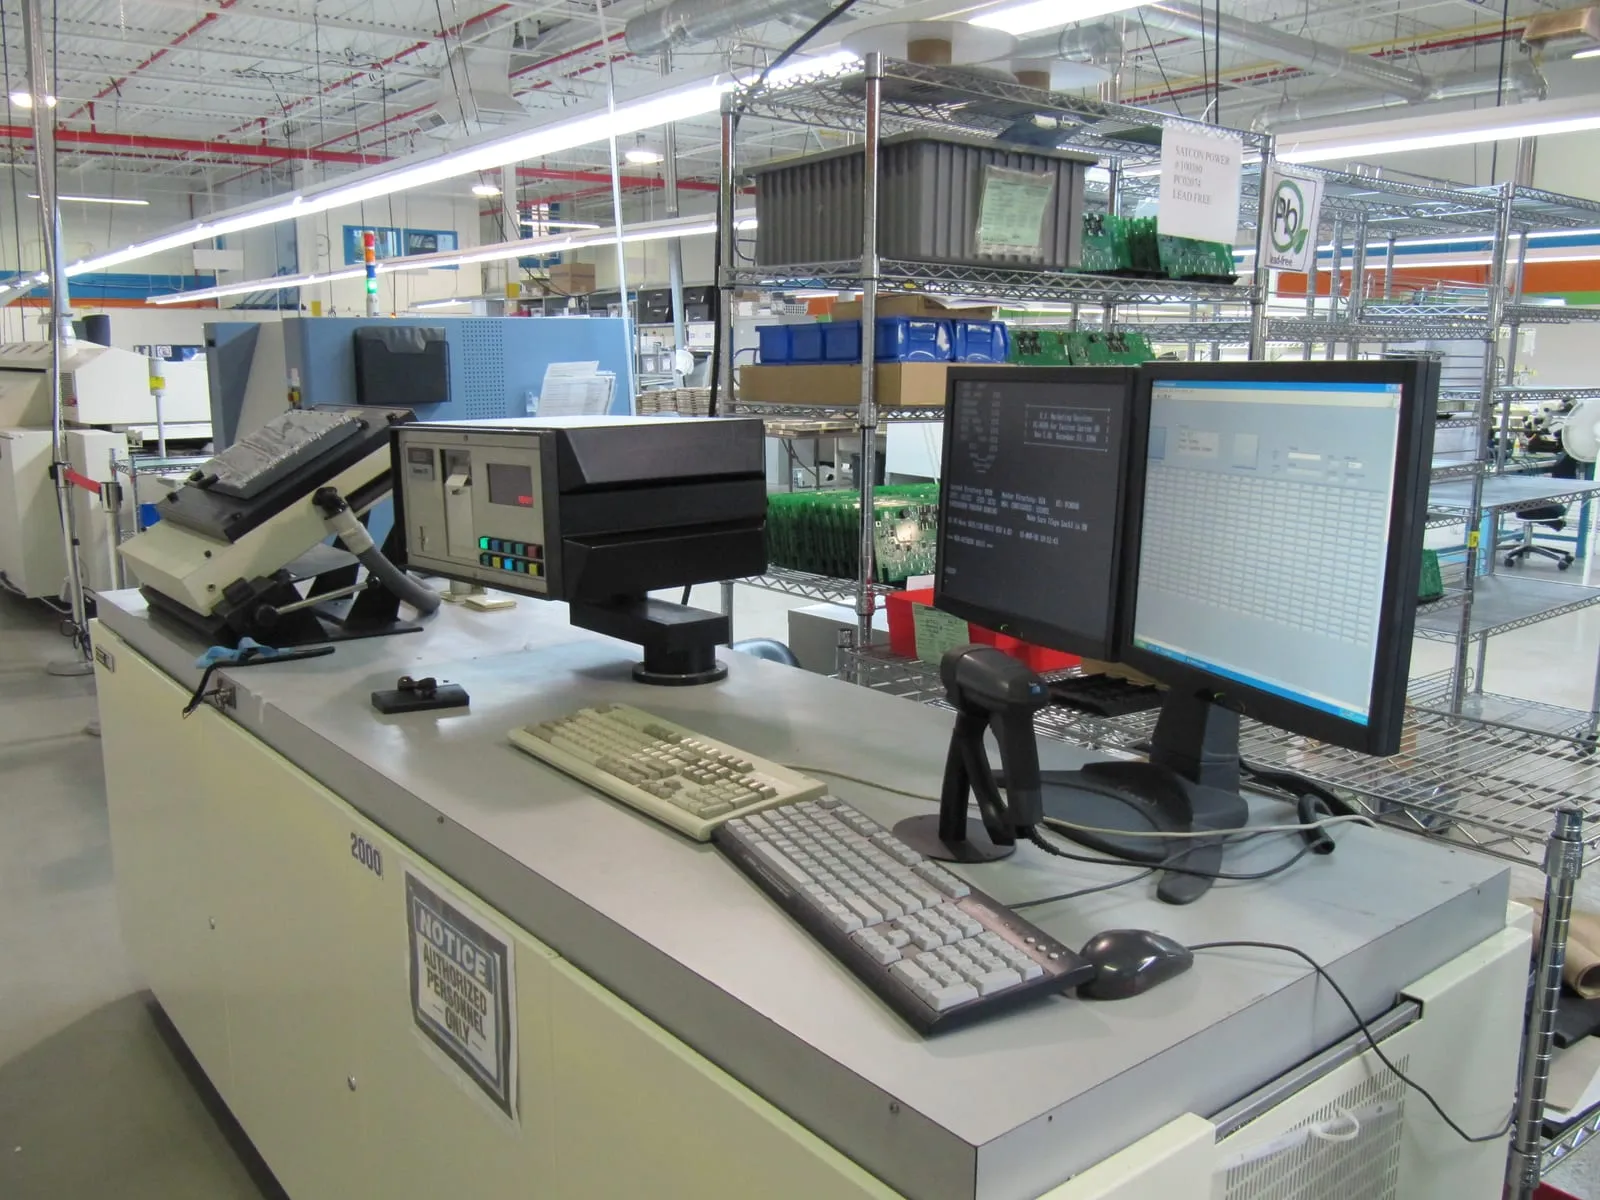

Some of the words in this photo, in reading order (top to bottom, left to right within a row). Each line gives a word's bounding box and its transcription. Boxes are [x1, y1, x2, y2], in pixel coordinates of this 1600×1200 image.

[1205, 151, 1231, 166] POWER
[1172, 188, 1193, 202] LEAD
[1193, 192, 1212, 206] FREE
[350, 832, 381, 876] 2000
[419, 907, 487, 984] NOTICE
[423, 942, 487, 1016] AUTHORIZED
[426, 966, 487, 1041] PERSONNEL
[444, 1006, 471, 1046] ONLY
